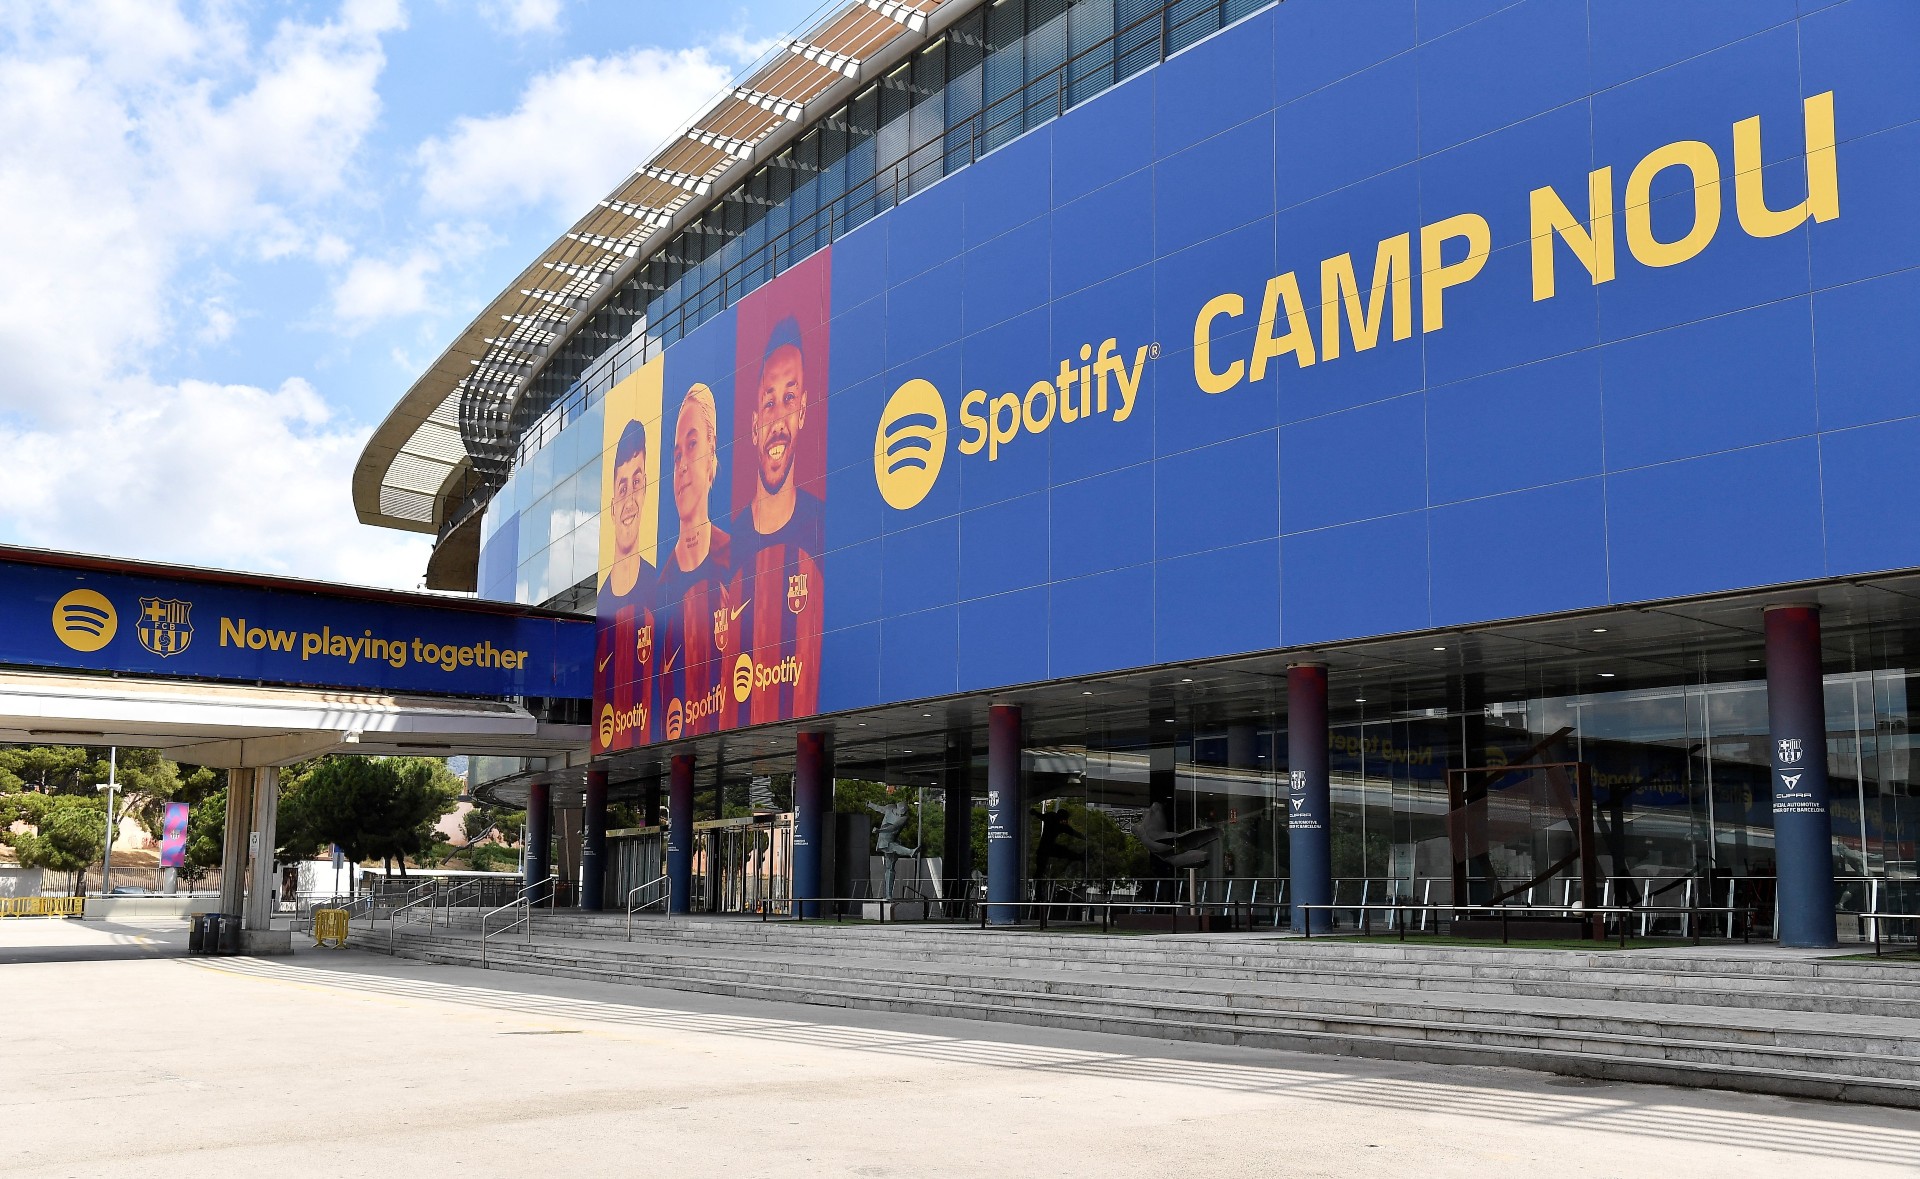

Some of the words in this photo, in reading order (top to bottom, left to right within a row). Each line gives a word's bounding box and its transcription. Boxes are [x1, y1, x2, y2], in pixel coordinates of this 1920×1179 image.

[1193, 211, 1491, 395] CAMP
[1528, 90, 1840, 302] NOU
[154, 622, 176, 631] FCB
[219, 616, 298, 652] Now
[302, 625, 408, 668] playing
[411, 637, 529, 672] together
[755, 655, 803, 692] Spotify
[615, 702, 648, 736] Spotify
[685, 683, 727, 726] Spotify
